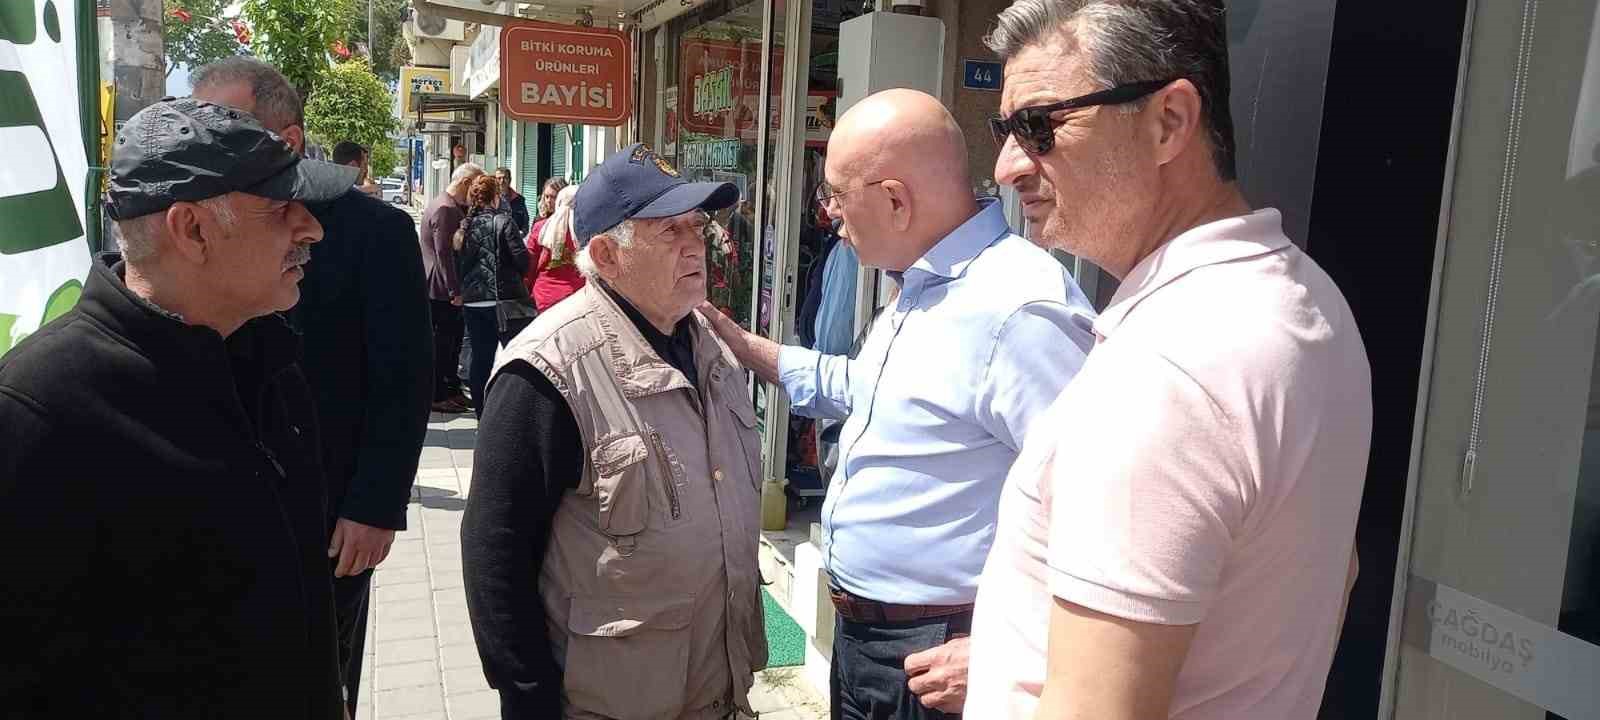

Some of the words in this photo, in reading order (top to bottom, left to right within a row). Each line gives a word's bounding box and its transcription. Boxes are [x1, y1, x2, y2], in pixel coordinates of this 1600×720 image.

[520, 39, 555, 53] BİTKİ
[558, 44, 615, 58] KORUMA
[535, 58, 600, 75] ÜRÜNLERİ
[974, 67, 992, 83] 44
[521, 80, 613, 110] BAYİSİ
[1440, 633, 1513, 674] mobilya
